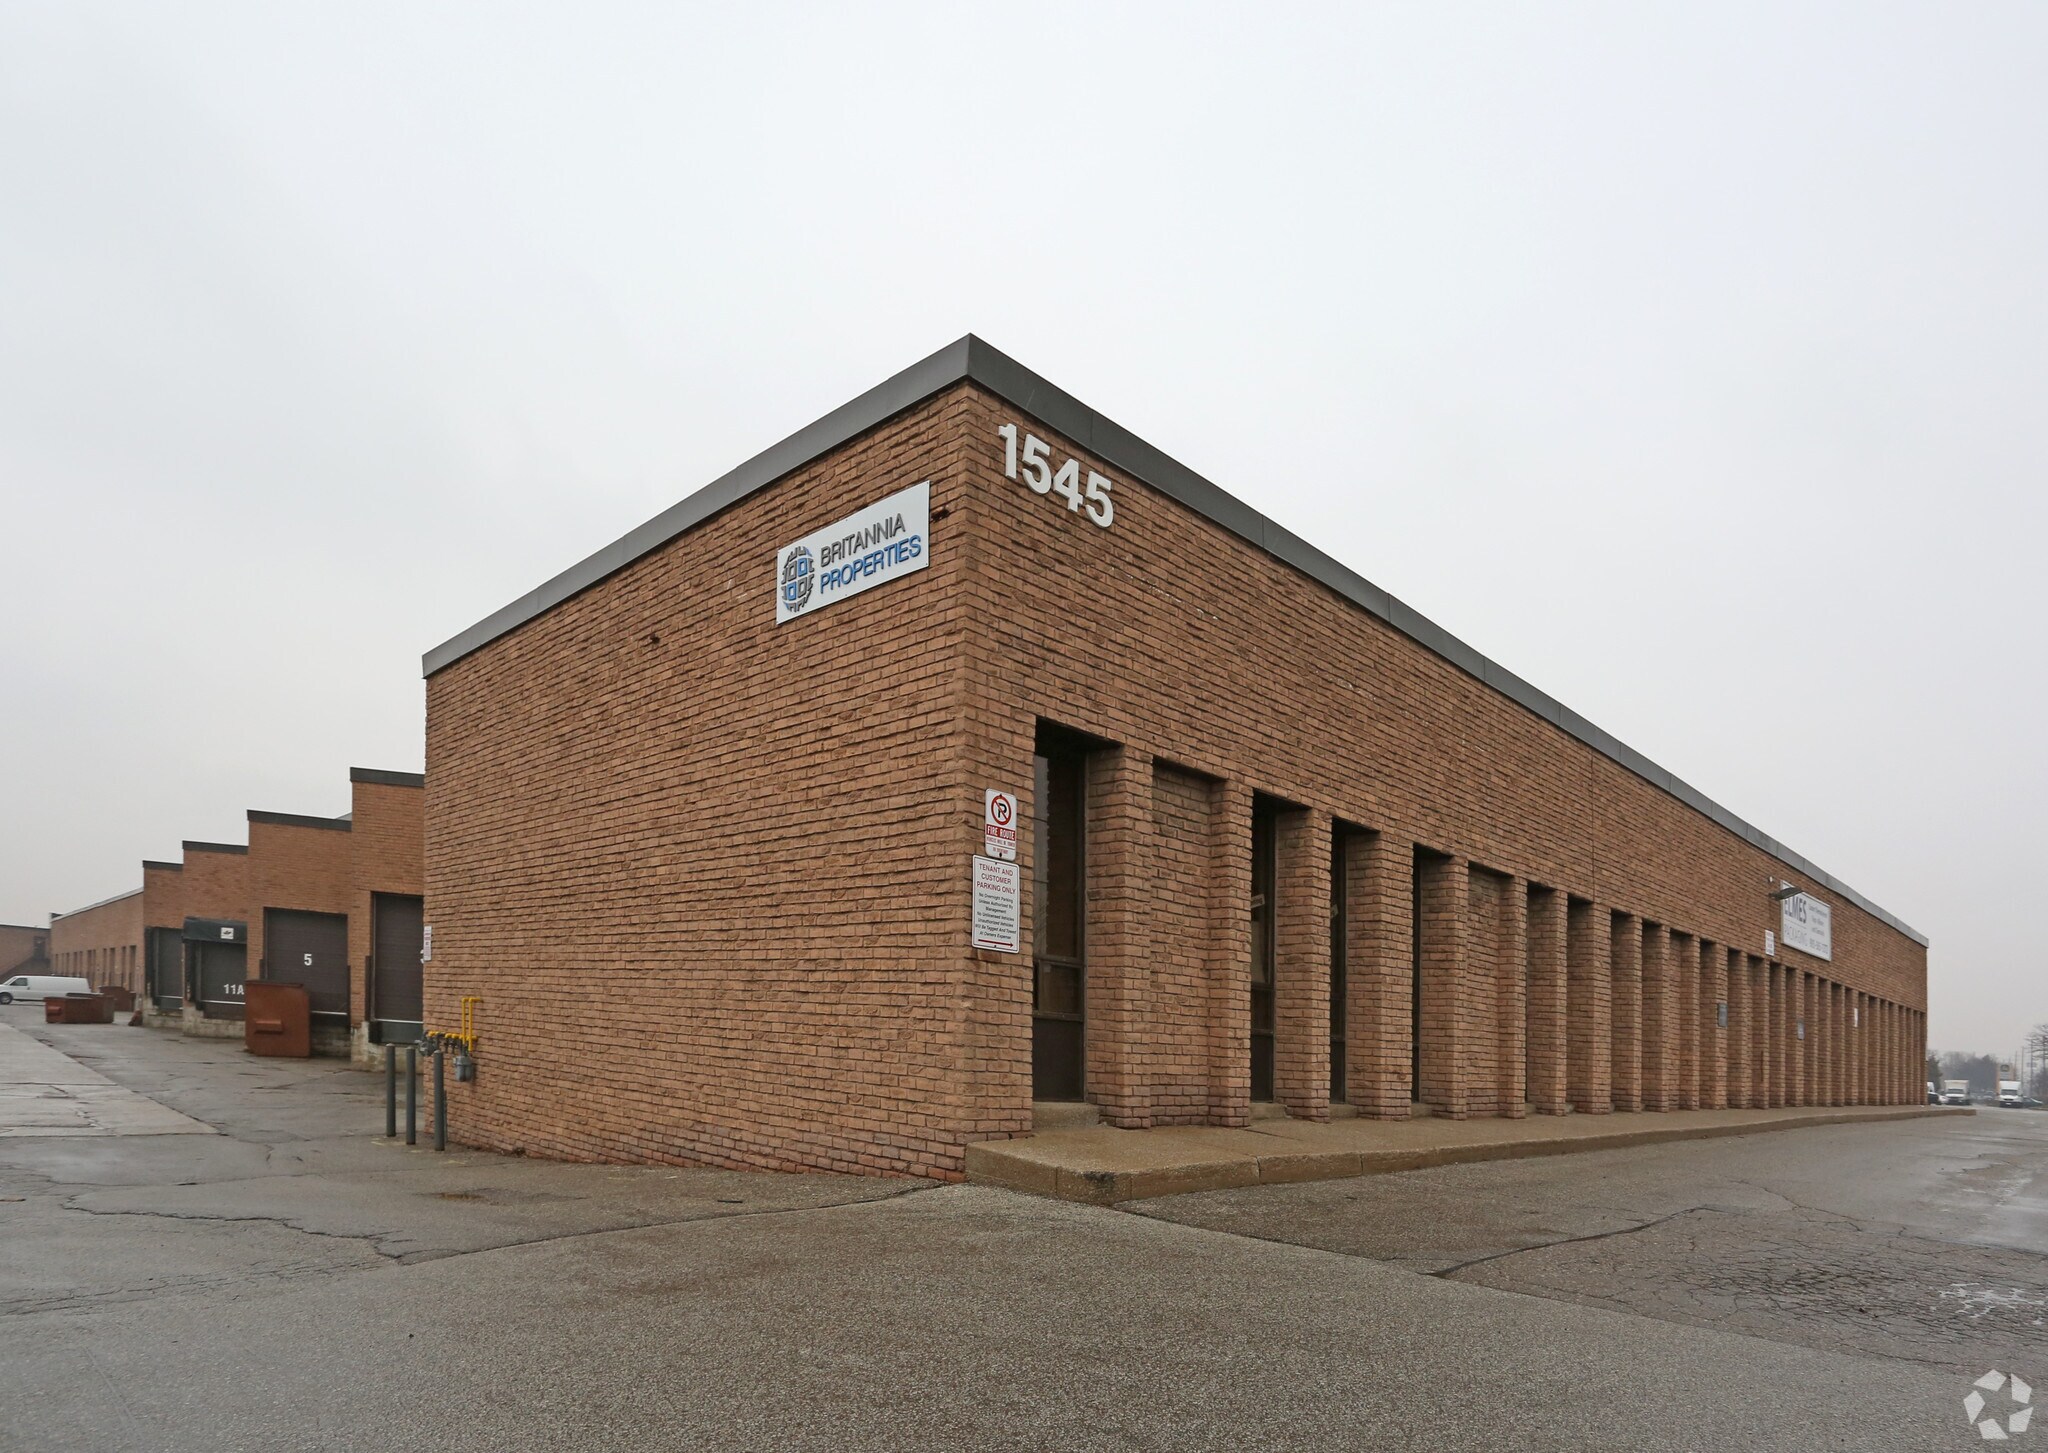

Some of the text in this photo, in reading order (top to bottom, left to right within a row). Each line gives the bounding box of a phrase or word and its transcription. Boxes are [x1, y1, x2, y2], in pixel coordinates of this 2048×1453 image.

[998, 423, 1114, 528] 1545
[820, 512, 906, 568] BRITANNIA
[820, 534, 922, 595] PROPERTIES
[987, 825, 1015, 840] FIRE ROUTE
[979, 864, 1001, 873] TENANT
[981, 873, 1012, 885] CUSTOMER
[976, 881, 1016, 894] PARKING ONLY
[303, 953, 313, 966] 5
[223, 983, 245, 995] 11A
